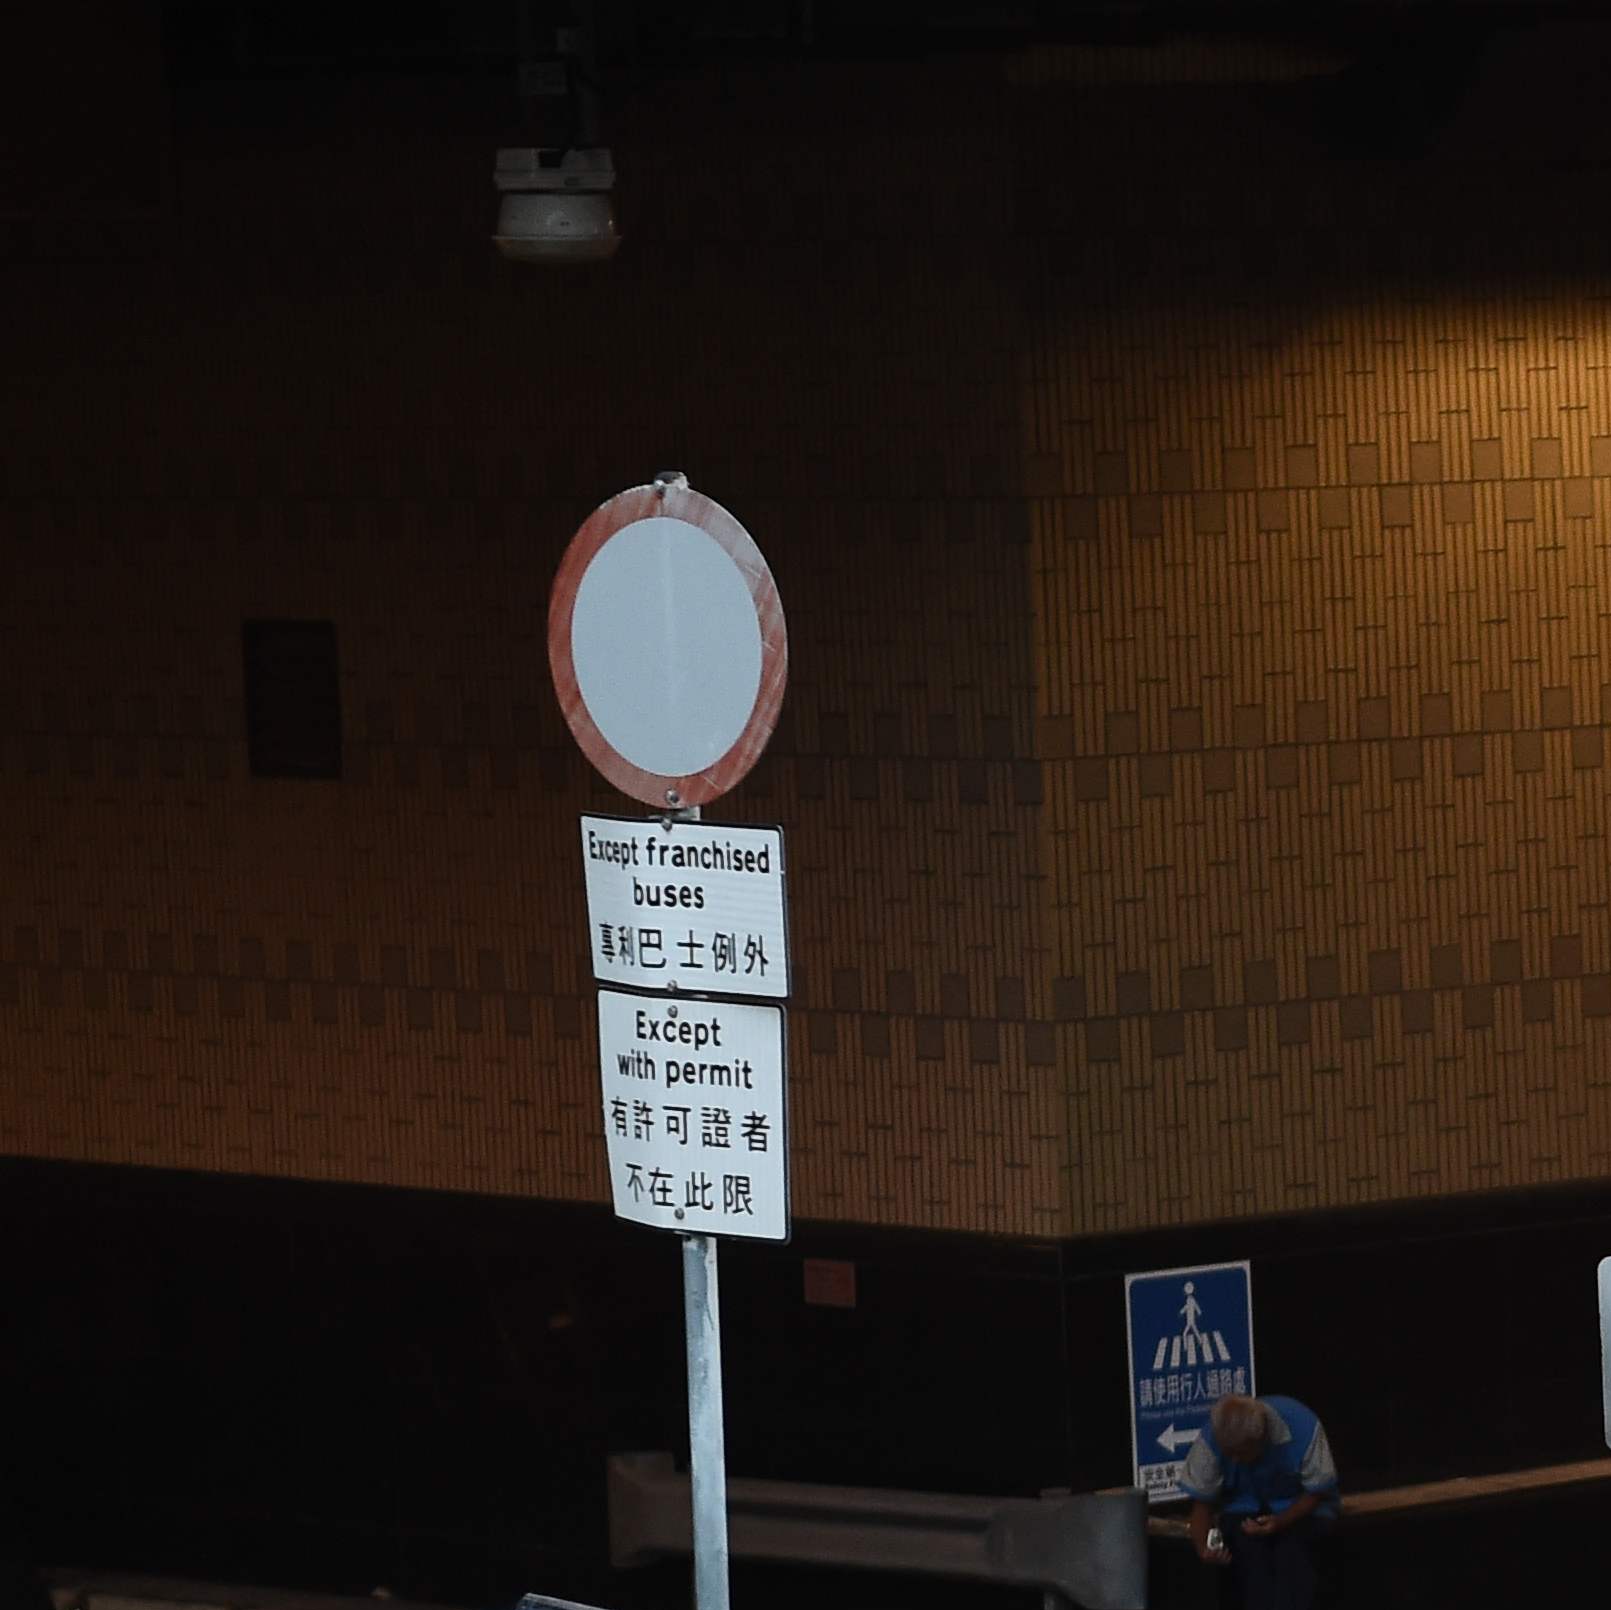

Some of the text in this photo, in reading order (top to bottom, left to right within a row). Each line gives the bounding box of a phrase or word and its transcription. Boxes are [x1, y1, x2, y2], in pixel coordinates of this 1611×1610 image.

[588, 830, 771, 874] Except franchised
[632, 876, 706, 909] buses
[598, 921, 770, 977] 專利巴士例外
[635, 1010, 722, 1052] Except
[616, 1049, 754, 1090] with permit
[610, 1098, 772, 1154] 有許可證者
[625, 1162, 754, 1216] 不在此限
